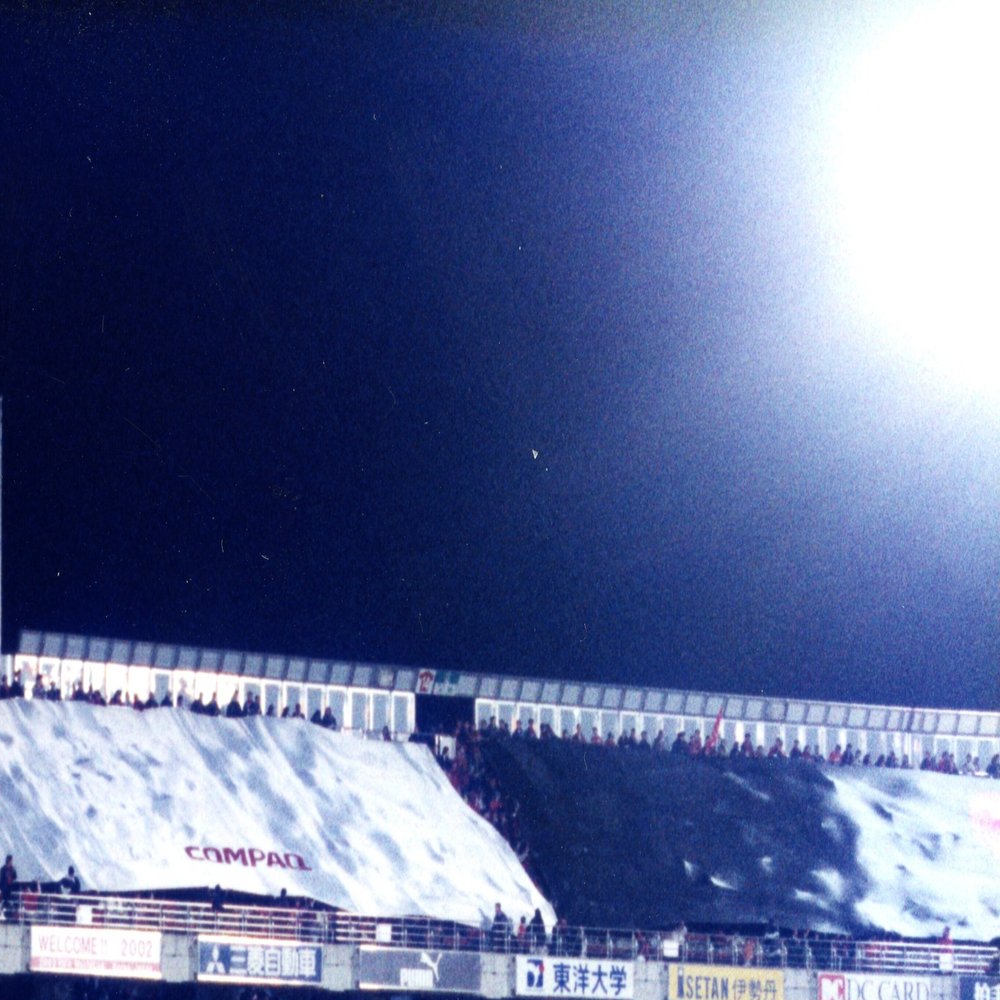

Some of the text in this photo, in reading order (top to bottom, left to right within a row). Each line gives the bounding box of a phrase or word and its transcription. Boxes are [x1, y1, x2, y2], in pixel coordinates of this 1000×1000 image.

[184, 846, 312, 871] COMPAQ
[120, 939, 153, 958] 2002
[229, 946, 317, 978] 三菱自動車
[553, 962, 627, 997] 東洋大学
